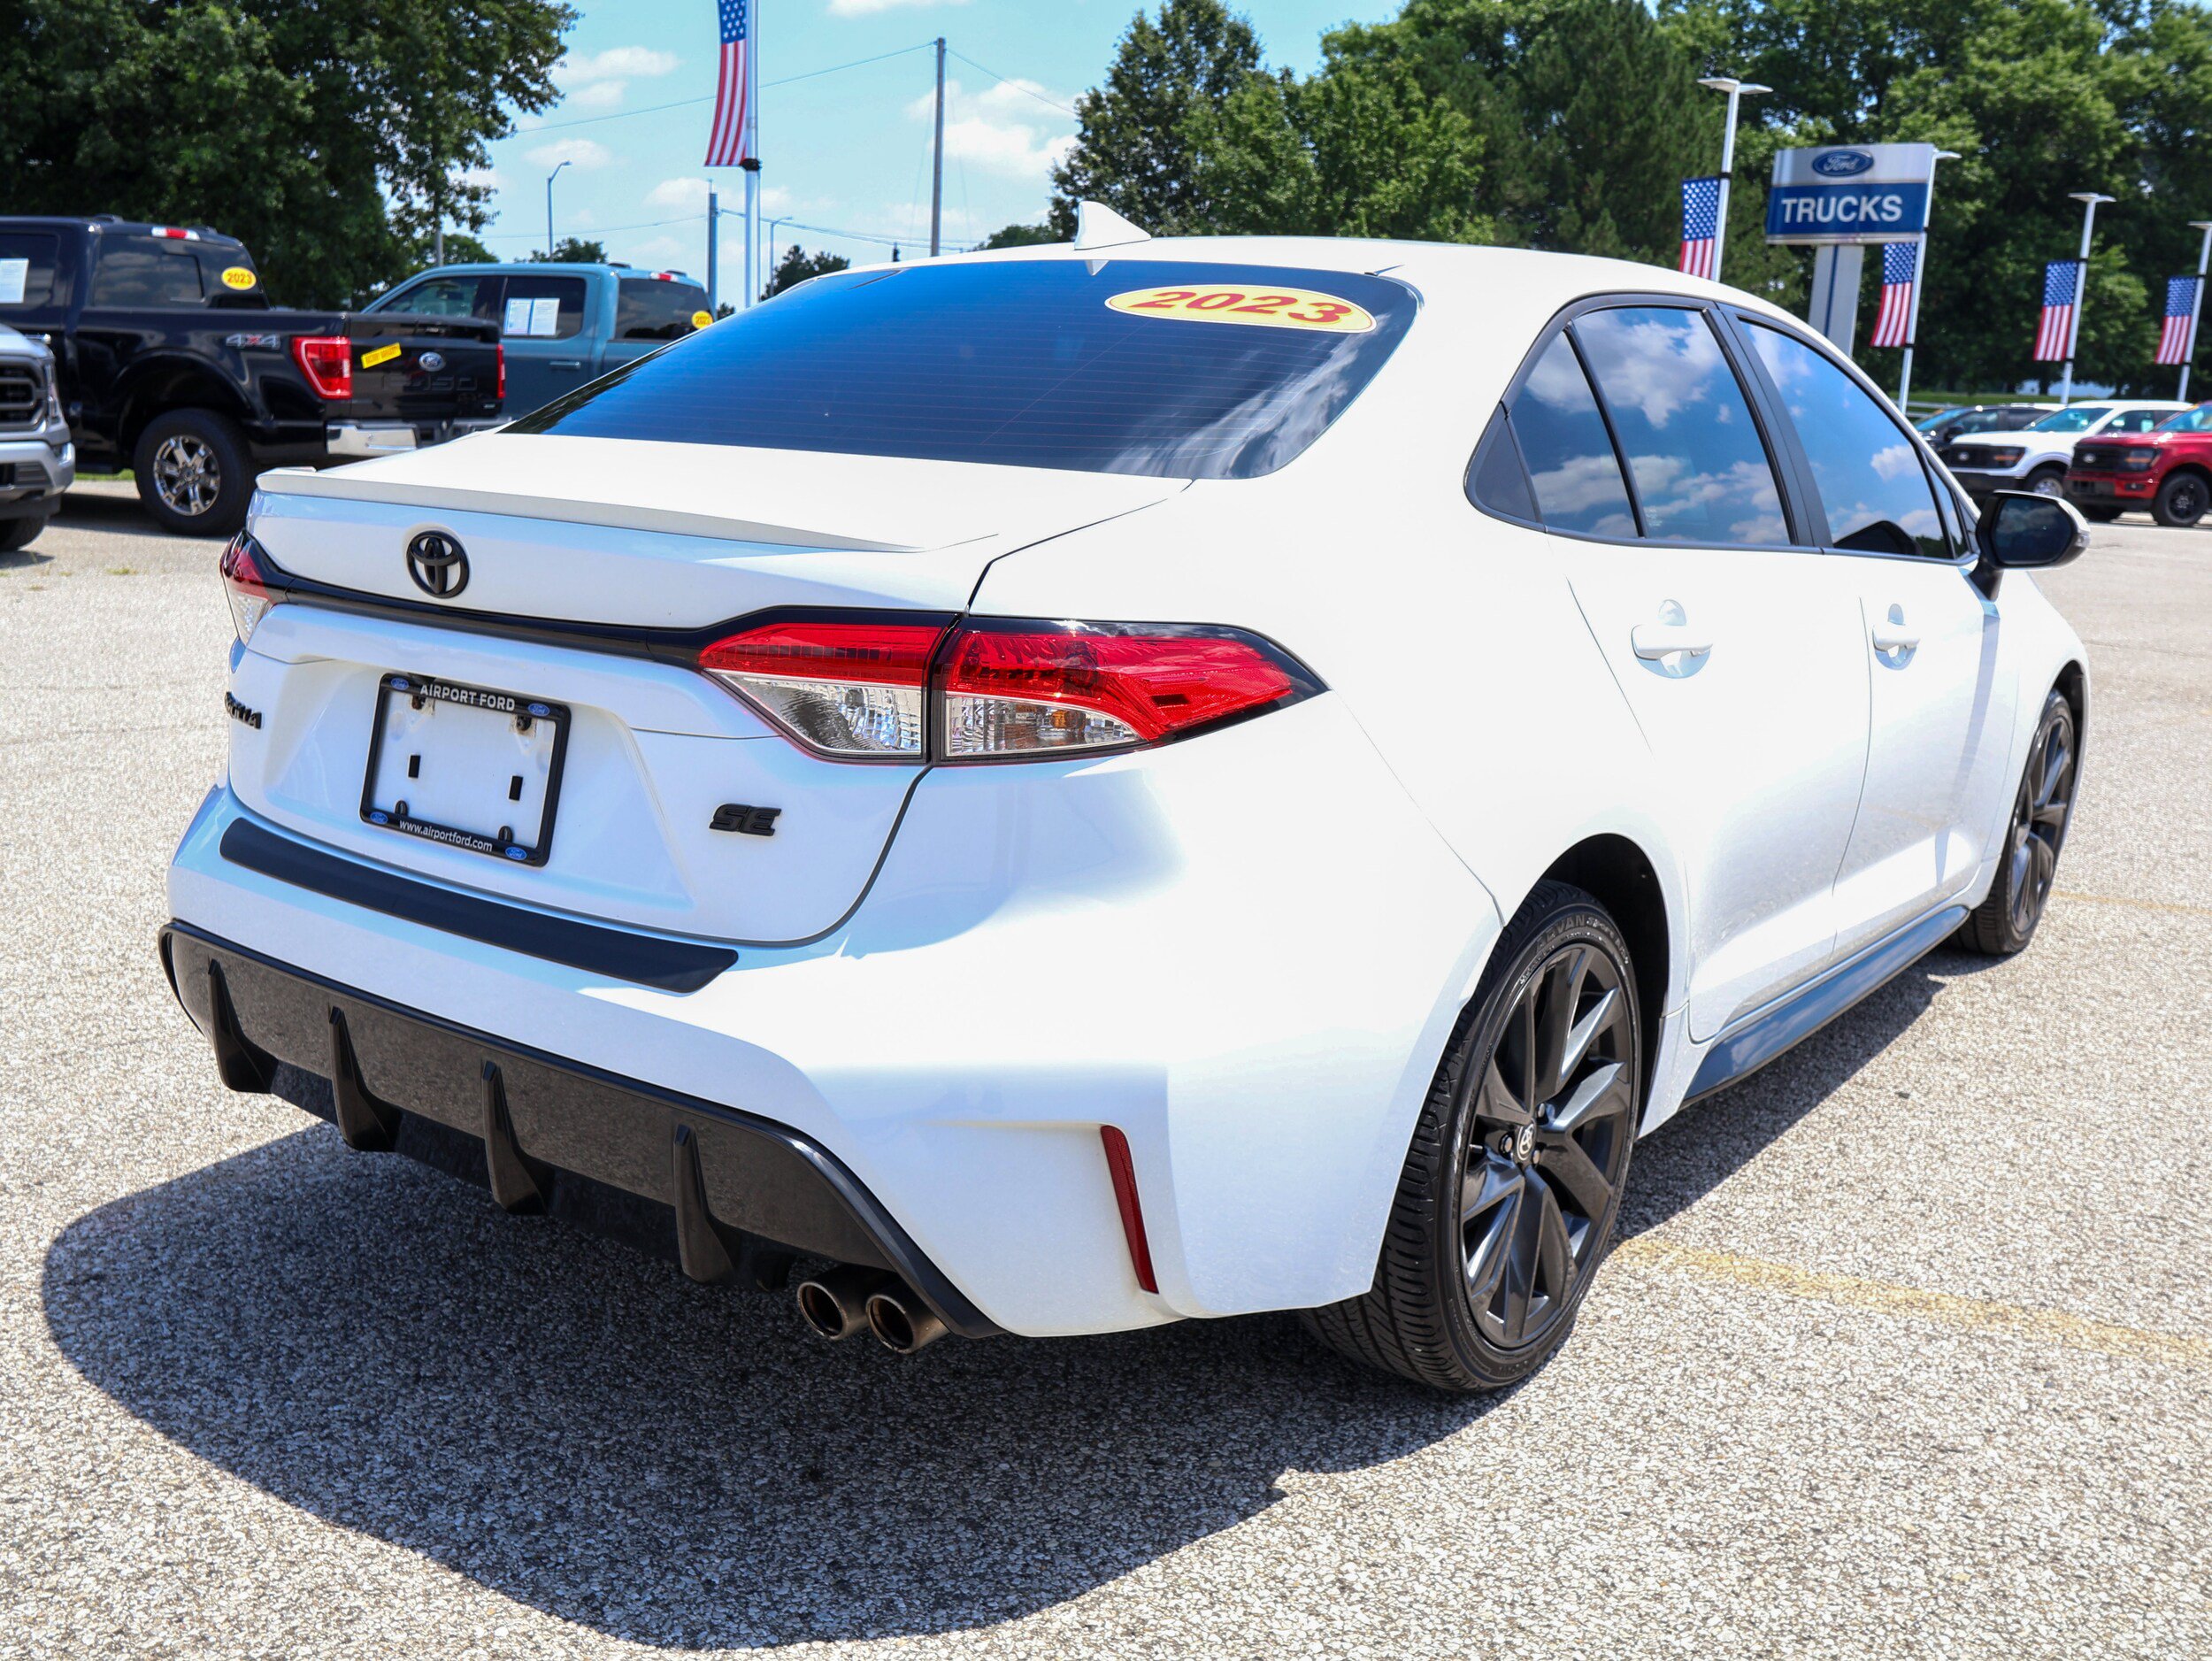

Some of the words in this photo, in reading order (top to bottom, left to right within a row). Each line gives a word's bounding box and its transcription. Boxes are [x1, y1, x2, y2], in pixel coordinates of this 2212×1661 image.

[1821, 152, 1862, 173] Ford
[1780, 193, 1903, 223] TRUCKS
[227, 273, 252, 285] 2023
[1127, 290, 1353, 324] 2023
[420, 683, 478, 704] AIRPORT
[479, 693, 516, 711] FORD
[709, 803, 782, 837] SE
[399, 819, 493, 852] www.airportford.com
